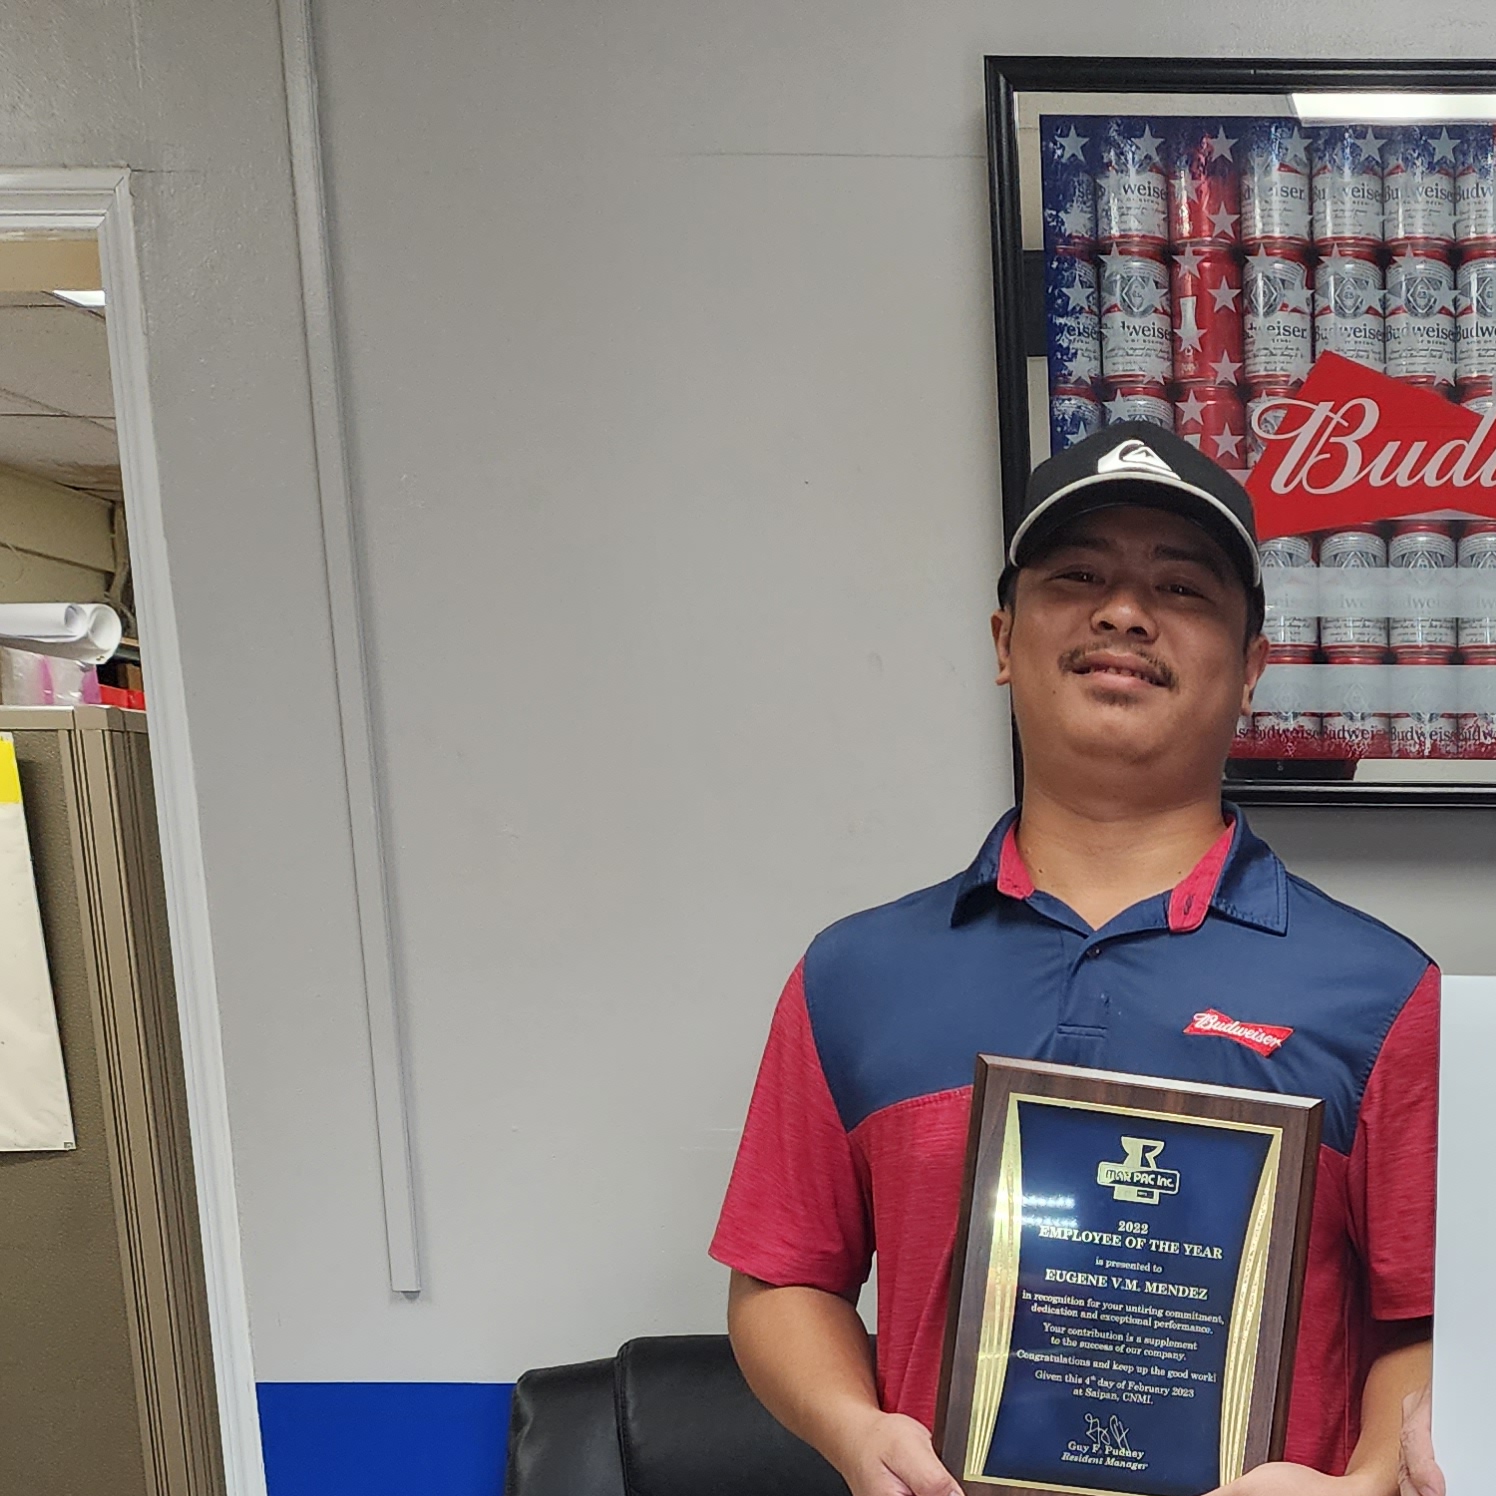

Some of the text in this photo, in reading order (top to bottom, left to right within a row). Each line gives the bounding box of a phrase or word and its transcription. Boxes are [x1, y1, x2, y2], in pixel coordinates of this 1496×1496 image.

[1193, 1012, 1282, 1048] Budweiser
[1106, 1169, 1131, 1183] MAR
[1133, 1172, 1155, 1186] PAC
[1118, 1220, 1149, 1235] 2022
[1038, 1225, 1223, 1260] EMPLOYEE OF THE YEAR
[1095, 1256, 1163, 1273] is presented to
[1045, 1269, 1209, 1300] EUGENE V.M. MENDEZ
[1022, 1290, 1225, 1325] in recognition for your untiring commitment,
[1031, 1303, 1213, 1334] dedication and exceptional performance.
[1043, 1322, 1065, 1335] Your
[1067, 1326, 1124, 1342] contribution
[1125, 1333, 1134, 1342] is
[1144, 1336, 1198, 1351] supplement
[1051, 1336, 1187, 1361] to the success of our company.
[1016, 1350, 1217, 1383] Congratulations and keep up the good work!
[1035, 1370, 1062, 1382] Given
[1064, 1373, 1083, 1385] this
[1097, 1377, 1115, 1389] day
[1116, 1379, 1126, 1390] of
[1127, 1381, 1170, 1397] February
[1171, 1386, 1195, 1399] 2023
[1073, 1387, 1083, 1396] at
[1084, 1387, 1120, 1401] Saipan,
[1061, 1452, 1148, 1471] Resident Manager
[1067, 1440, 1089, 1453] Guy
[1105, 1445, 1145, 1459] Pudney
